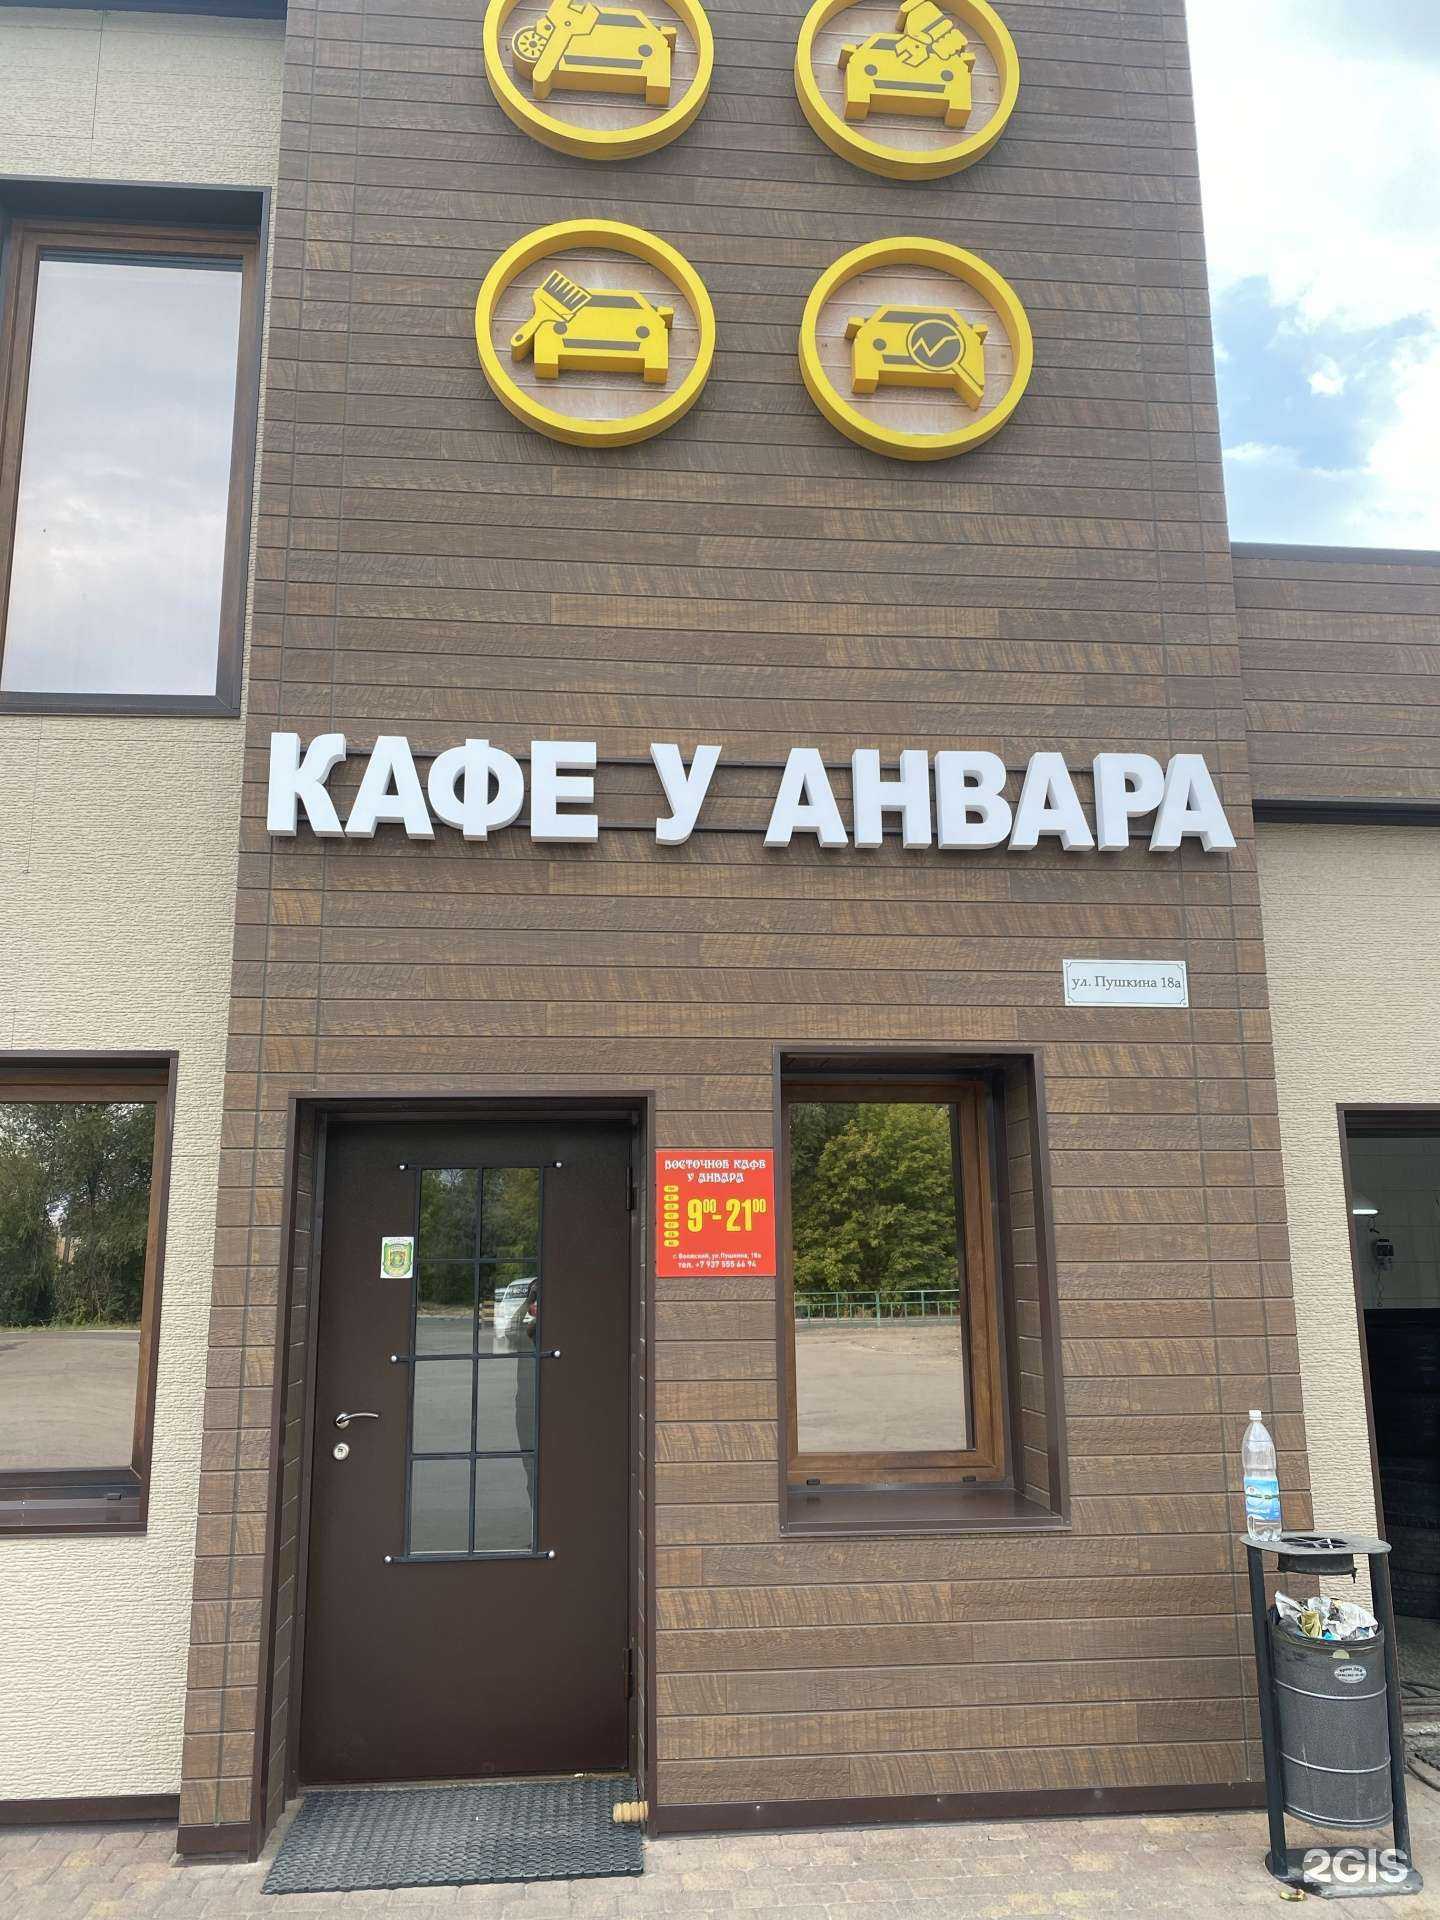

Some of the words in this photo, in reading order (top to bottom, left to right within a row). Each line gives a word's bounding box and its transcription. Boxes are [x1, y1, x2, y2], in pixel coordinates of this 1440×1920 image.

[267, 732, 598, 843] КАФЕ
[649, 742, 722, 845] У
[762, 748, 1236, 852] АНВАРА
[1072, 977, 1091, 990] ул.
[1094, 976, 1157, 991] Пушкина
[1161, 977, 1181, 988] 18а
[664, 1160, 729, 1170] ВОСТОЧНОЕ
[733, 1160, 766, 1170] КАФЕ
[687, 1173, 695, 1183] У
[698, 1173, 744, 1183] АНВАРА
